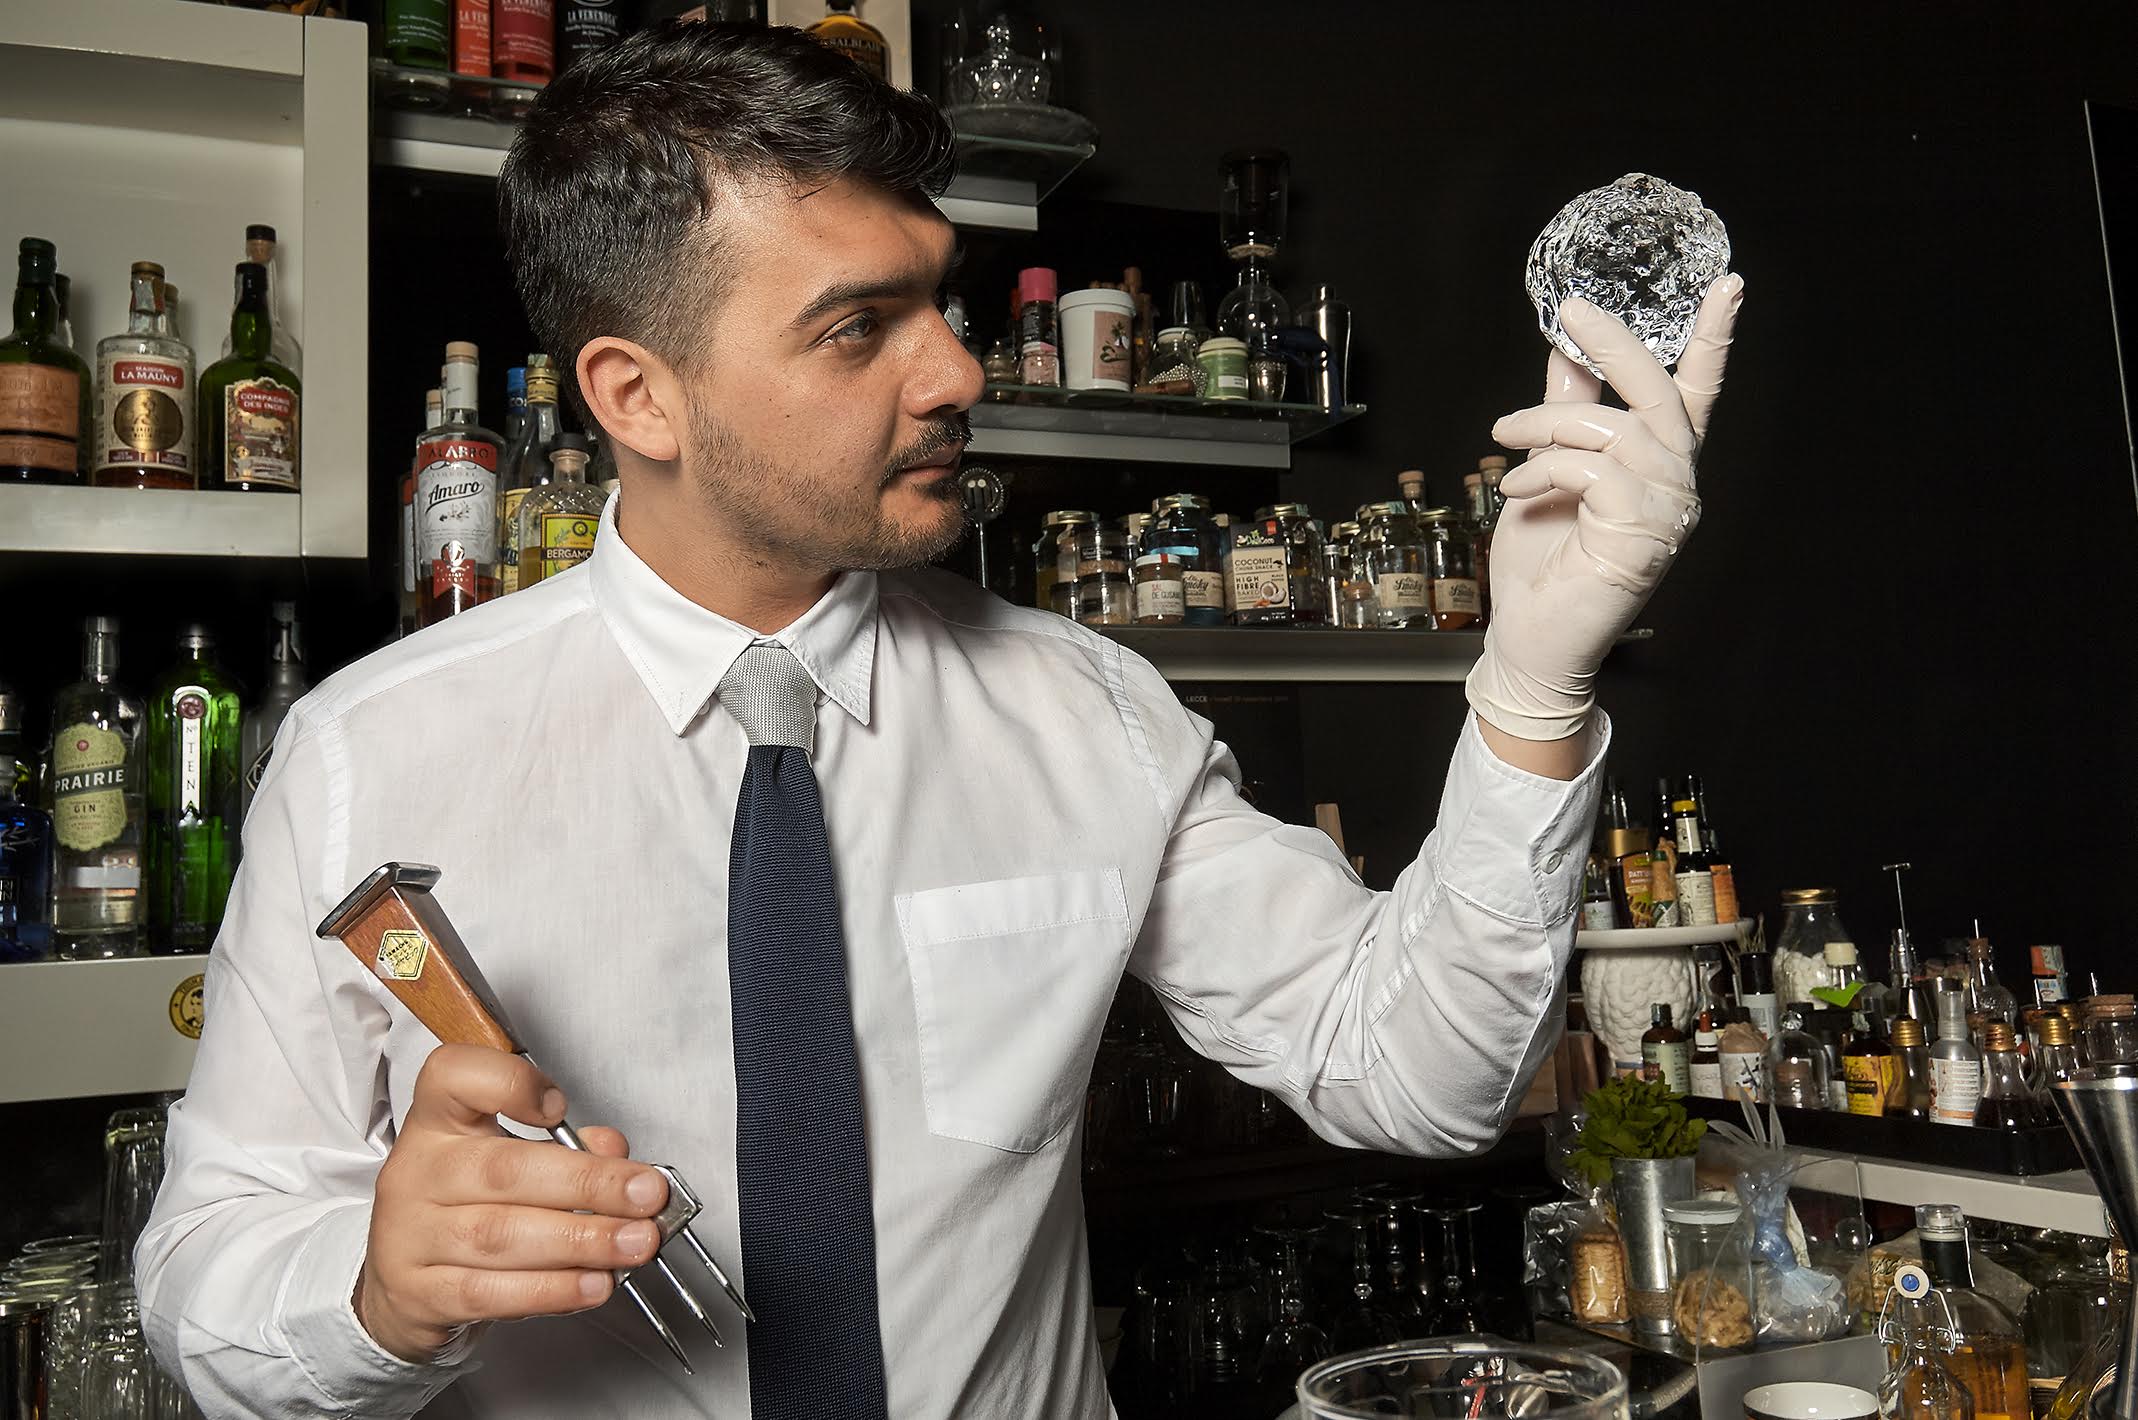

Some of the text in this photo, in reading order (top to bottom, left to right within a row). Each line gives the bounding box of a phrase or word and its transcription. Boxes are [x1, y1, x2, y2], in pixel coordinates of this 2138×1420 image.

[121, 371, 178, 384] LA MAUNY
[243, 400, 262, 409] DES
[427, 481, 482, 504] Amaro
[1234, 558, 1273, 567] COCONUT
[1151, 591, 1160, 600] DE
[186, 742, 196, 791] TEN
[54, 768, 125, 793] PRAIRIE
[73, 804, 96, 814] GIN
